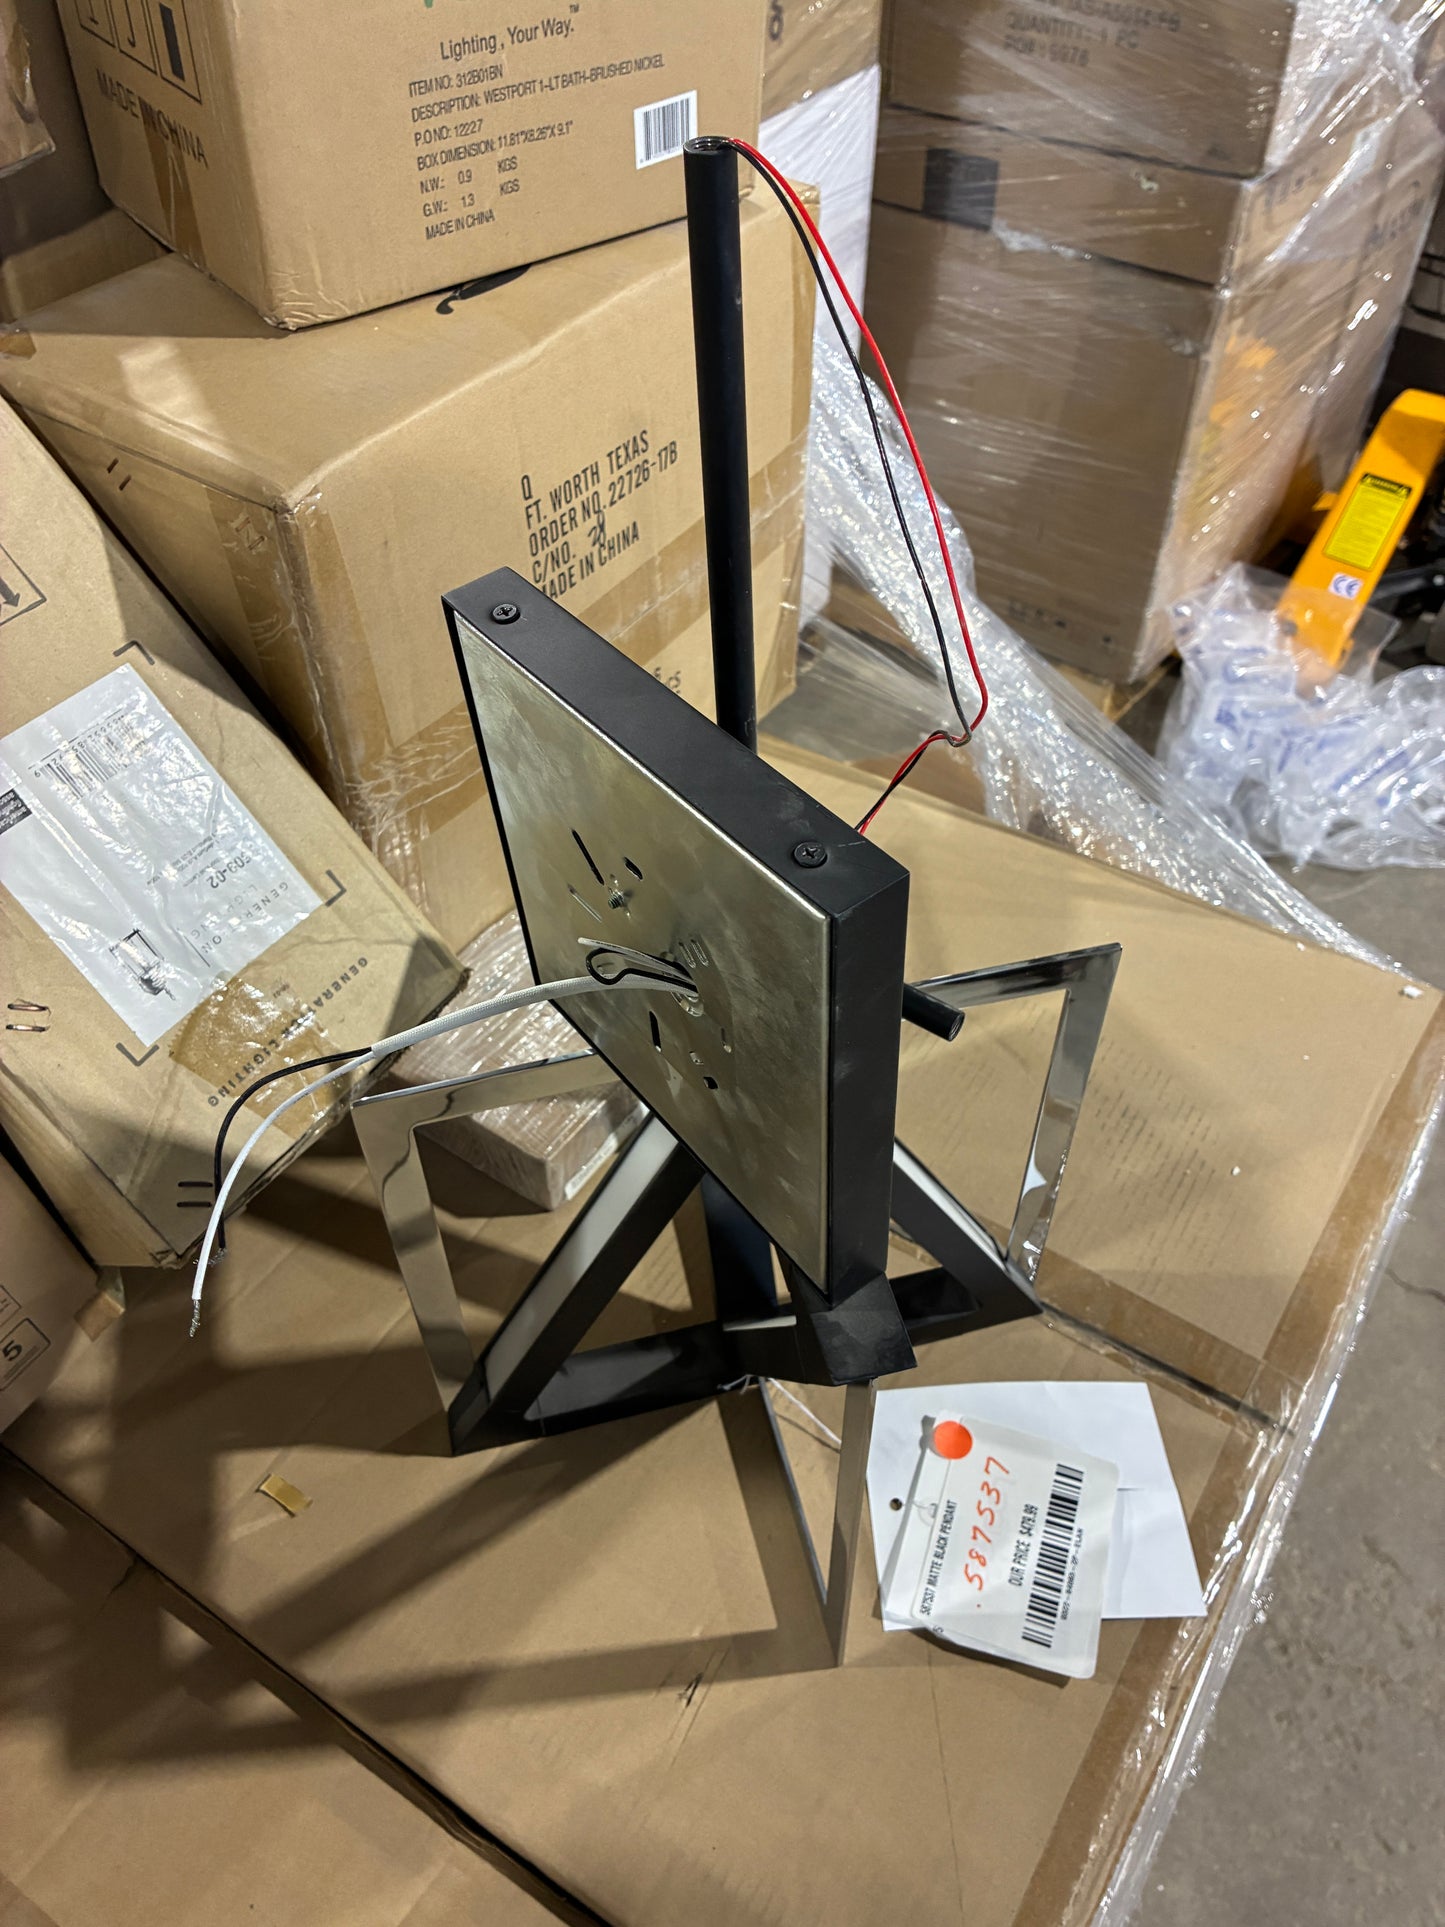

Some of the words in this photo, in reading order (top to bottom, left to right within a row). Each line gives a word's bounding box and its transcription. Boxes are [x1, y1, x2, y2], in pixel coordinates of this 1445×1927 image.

[507, 25, 540, 46] Your
[541, 16, 575, 38] Way.
[408, 77, 434, 98] ITEM
[434, 75, 454, 94] NO:
[456, 64, 504, 89] 312B01BN
[411, 92, 482, 122] DESCRIPTION:
[484, 79, 537, 104] WESTPORT
[634, 53, 666, 73] NICKEL
[96, 66, 141, 119] MADE
[157, 109, 209, 170] CHINA
[454, 118, 484, 138] 12227
[417, 152, 439, 171] BOX
[440, 138, 496, 164] DIMENSION:
[457, 169, 473, 185] 0.9
[497, 155, 518, 174] KGS
[461, 193, 476, 209] 1.3
[499, 178, 521, 197] KGS
[425, 220, 455, 241] MADE
[454, 216, 465, 232] IN
[467, 208, 496, 228] CHINA
[525, 498, 548, 530] FT.
[549, 461, 601, 513] WORTH
[606, 429, 649, 475] TEXAS
[529, 506, 578, 557] ORDER
[580, 490, 608, 522] NO.
[608, 440, 679, 508] 22726-17B
[532, 540, 577, 585] C/NO.
[579, 552, 595, 580] IN
[598, 521, 641, 567] CHINA
[207, 1039, 280, 1107] LIGHTING
[940, 1499, 957, 1535] PENDANT
[964, 1456, 1010, 1591] 587537
[1019, 1503, 1039, 1537] $479.99
[933, 1535, 949, 1561] BLACK
[1013, 1540, 1031, 1566] PRICE
[926, 1560, 942, 1587] MATTE
[1008, 1566, 1025, 1588] OUR
